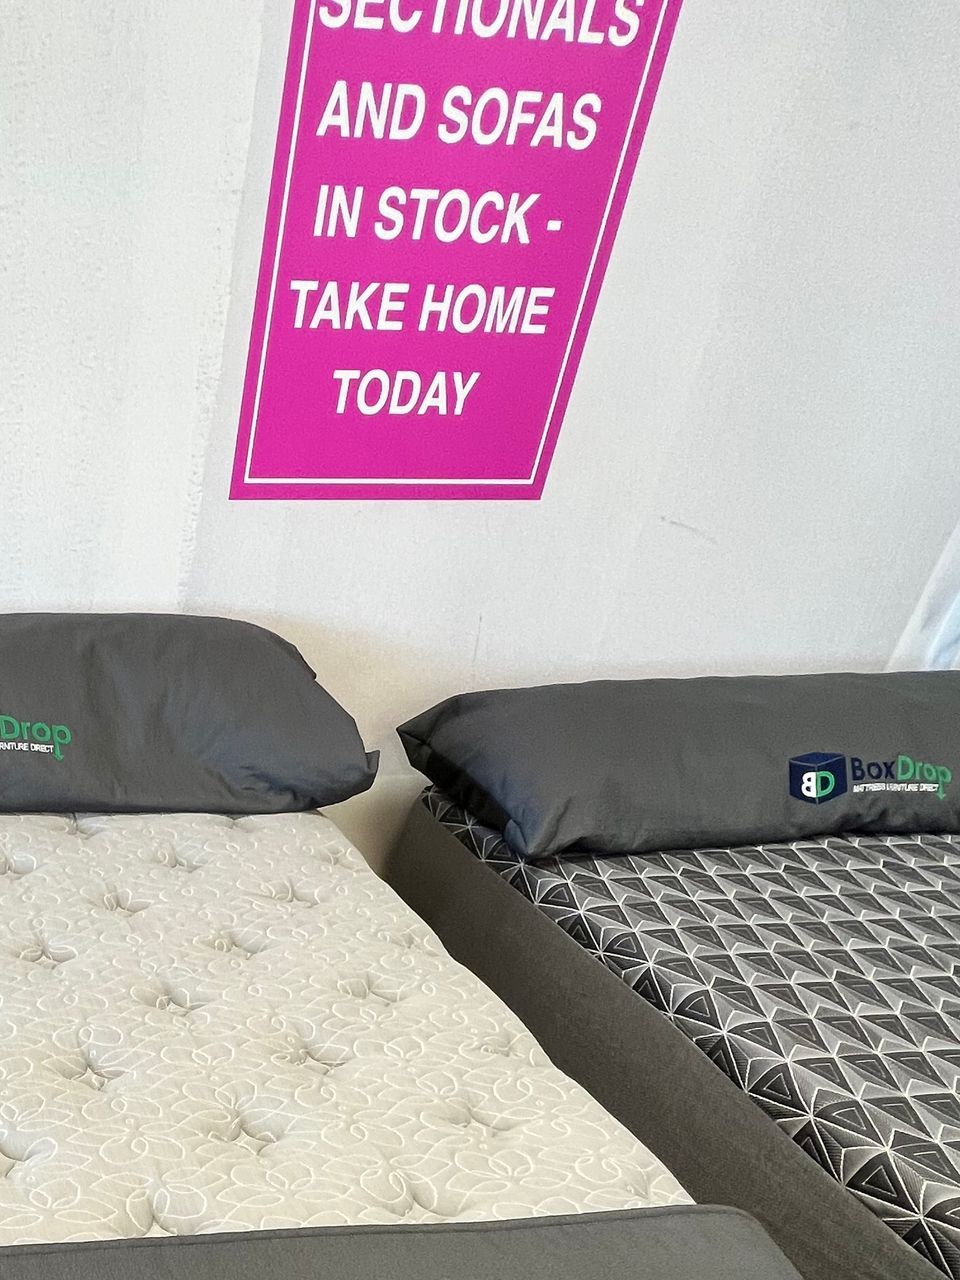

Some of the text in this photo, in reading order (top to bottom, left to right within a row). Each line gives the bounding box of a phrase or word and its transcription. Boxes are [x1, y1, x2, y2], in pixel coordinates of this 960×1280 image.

[316, 80, 602, 151] AND SOFAS
[313, 184, 364, 238] IN
[374, 186, 541, 245] STOCK
[289, 280, 556, 335] TAKE HOME
[333, 369, 481, 416] TODAY
[29, 743, 55, 753] DIRECT
[850, 754, 953, 800] BoxDrop
